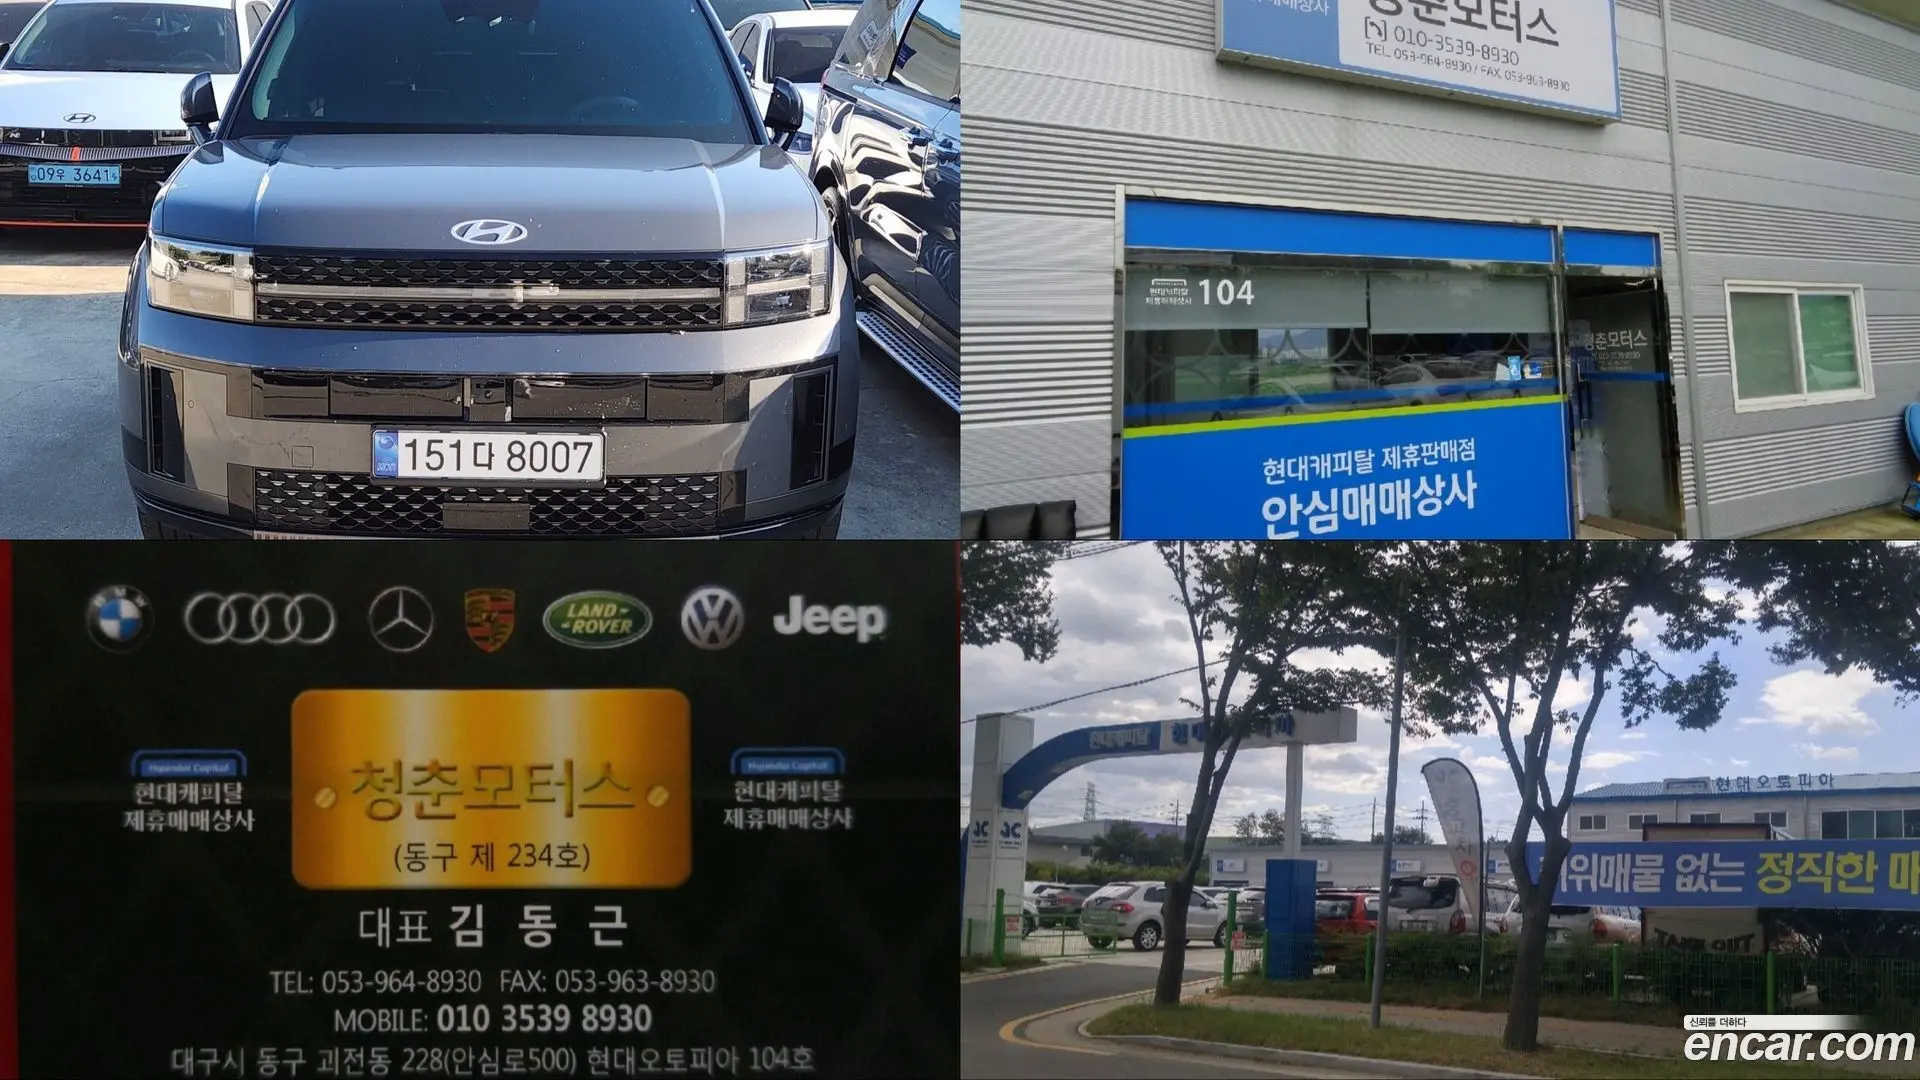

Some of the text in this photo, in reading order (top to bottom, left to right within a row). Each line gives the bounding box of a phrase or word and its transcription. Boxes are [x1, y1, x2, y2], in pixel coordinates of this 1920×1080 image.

[1394, 25, 1520, 67] 010-3539-8930
[1393, 48, 1473, 74] 053-964-8930
[1504, 69, 1571, 93] 053-963-8930
[36, 167, 110, 182] 09우 3641
[1198, 278, 1255, 306] 104
[404, 437, 594, 474] 151다 8007
[1262, 437, 1476, 486] 현대캐피탈 제휴판매점
[1261, 469, 1478, 540] 안심매매상사
[567, 603, 617, 618] LAND
[773, 594, 887, 643] Jeep
[571, 618, 632, 634] ROVER
[134, 782, 244, 805] 현대캐피탈
[352, 759, 635, 821] 청춘모터스
[734, 780, 843, 803] 현대캐피탈
[1715, 772, 1835, 791] 현대오토피아
[123, 808, 256, 832] 제휴매매상사
[723, 807, 853, 830] 제휴매매상사
[394, 842, 591, 873] (동구 제 234호)
[1675, 853, 1745, 893] 없는
[1756, 852, 1879, 894] 정직한
[359, 904, 628, 949] 대표 김 동 근
[270, 969, 716, 994] TEL: 053-964-8930 FAX: 053-963-8930
[334, 1003, 652, 1033] MOBILE: 010 3539 8930
[172, 1046, 814, 1077] 대구시 동구 괴전동 228(안심로500) 현대오토피아 104호
